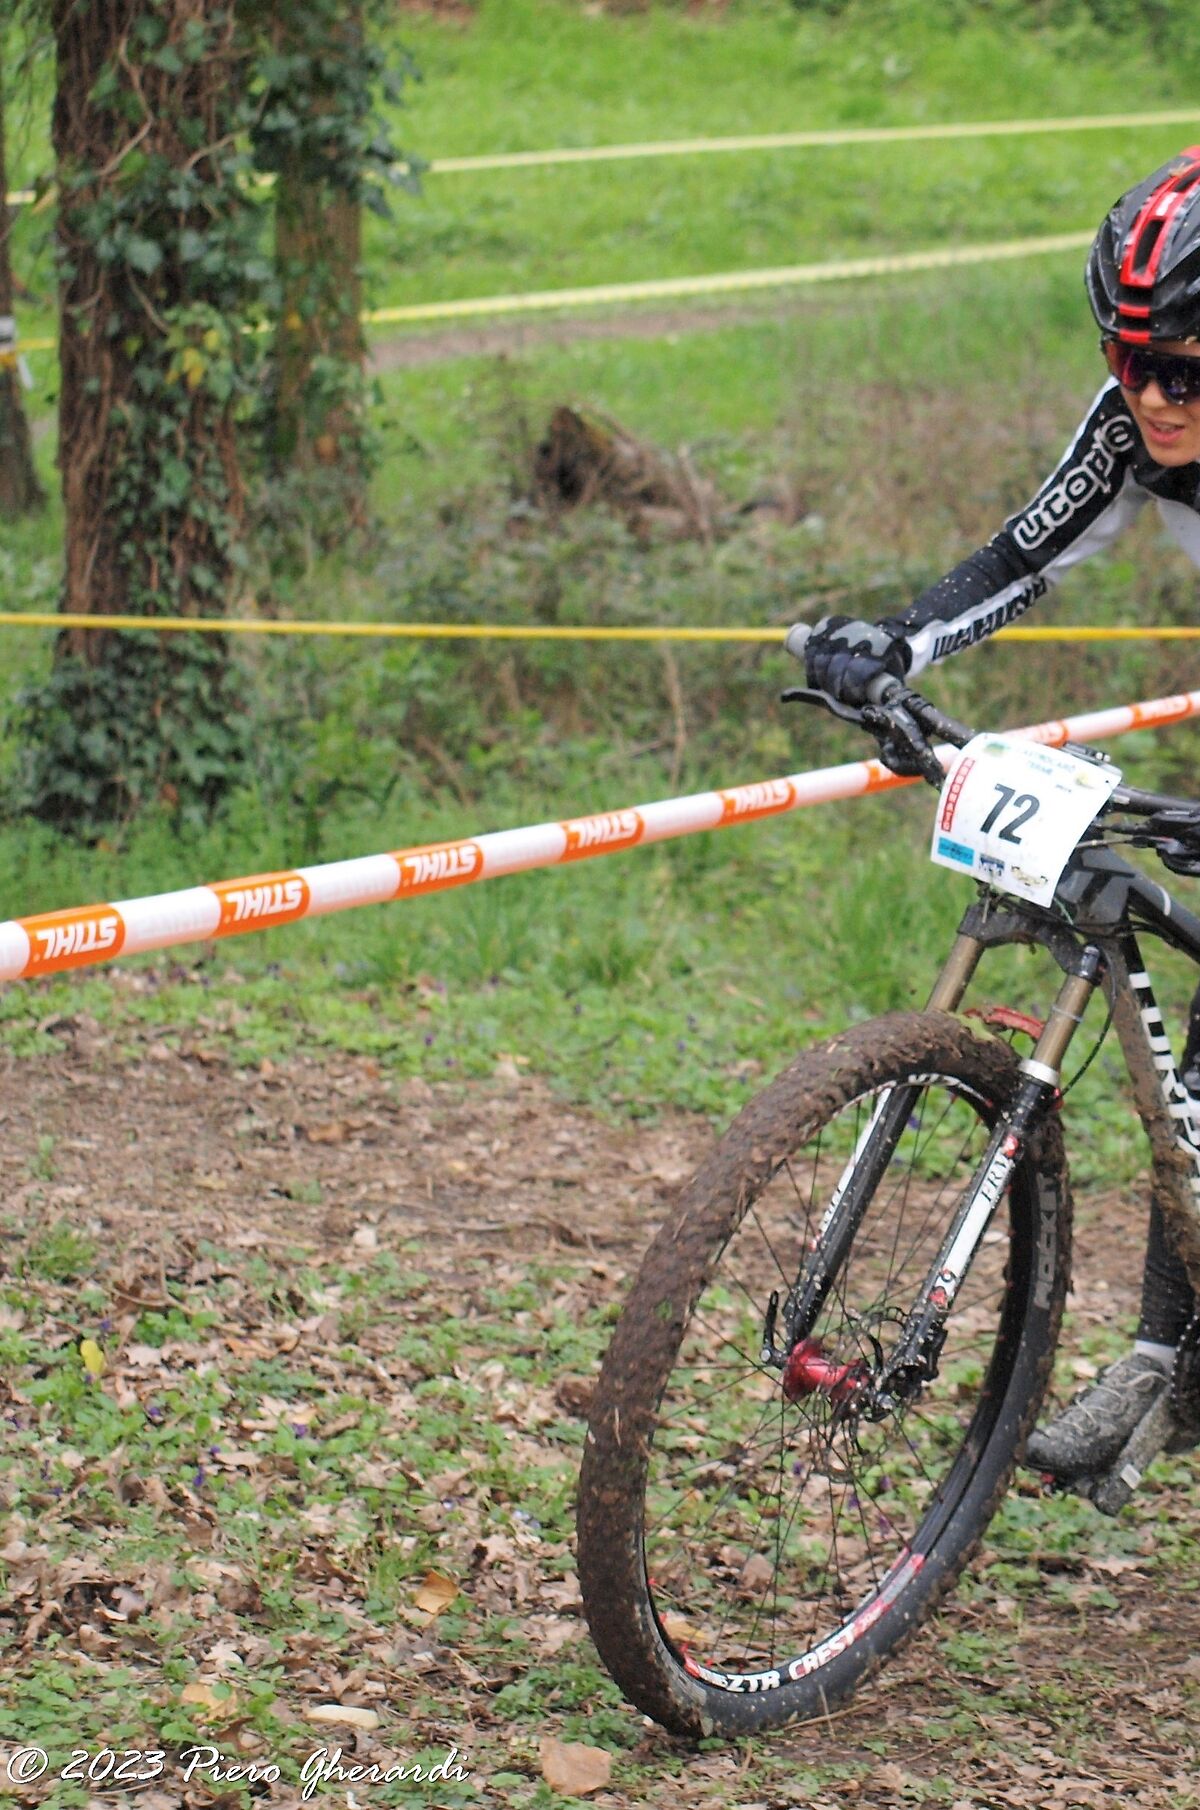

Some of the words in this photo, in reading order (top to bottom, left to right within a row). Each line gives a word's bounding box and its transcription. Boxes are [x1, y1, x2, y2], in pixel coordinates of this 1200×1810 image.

[722, 779, 790, 814] STIHL
[980, 783, 1041, 845] 72
[569, 812, 638, 848] STIHL
[404, 844, 478, 885] STIHL
[225, 879, 303, 921] STIHL
[36, 916, 118, 960] STIHL
[727, 1669, 780, 1693] ZTR
[788, 1623, 856, 1679] CREST
